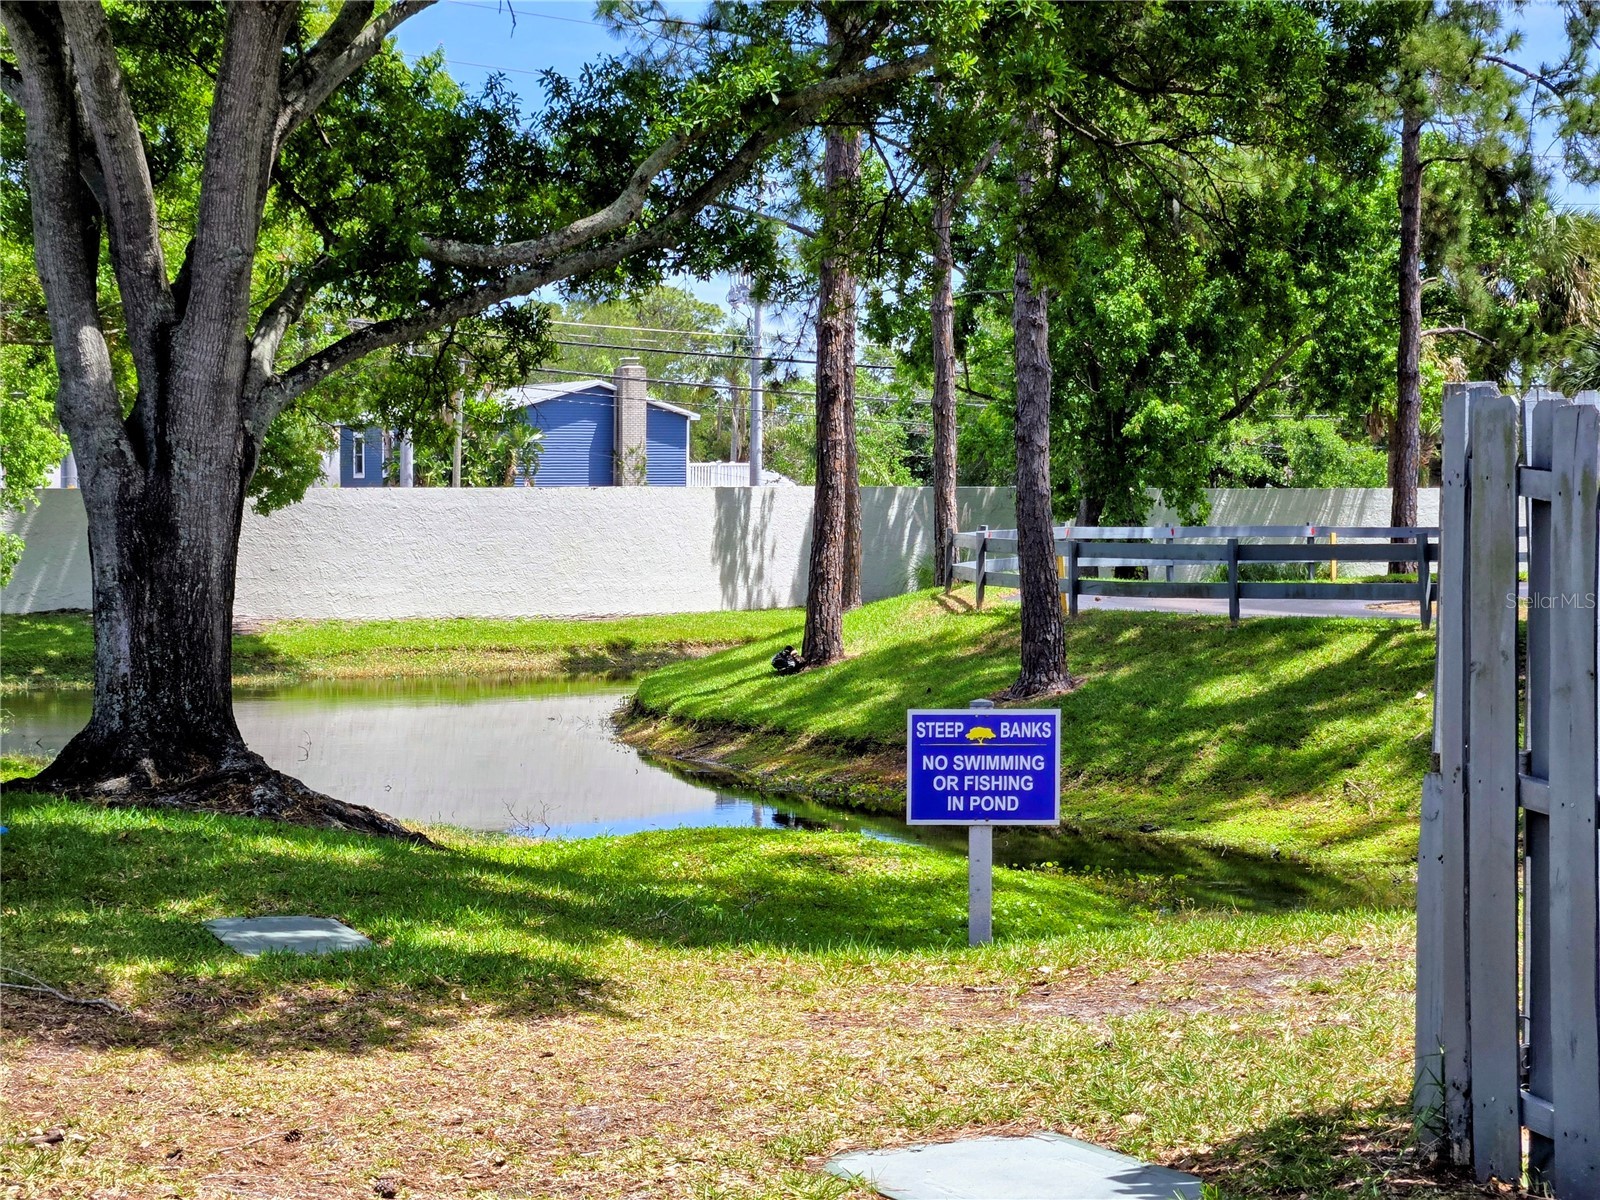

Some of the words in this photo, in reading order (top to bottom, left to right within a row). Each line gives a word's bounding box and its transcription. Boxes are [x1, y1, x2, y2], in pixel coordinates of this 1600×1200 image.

[916, 721, 964, 738] STEEP
[1000, 721, 1052, 738] BANKS
[922, 755, 948, 771] NO
[953, 755, 1045, 771] SWIMMING
[932, 775, 959, 791] OR
[964, 775, 1034, 791] FISHING
[947, 795, 964, 811] IN
[969, 795, 1019, 811] POND
